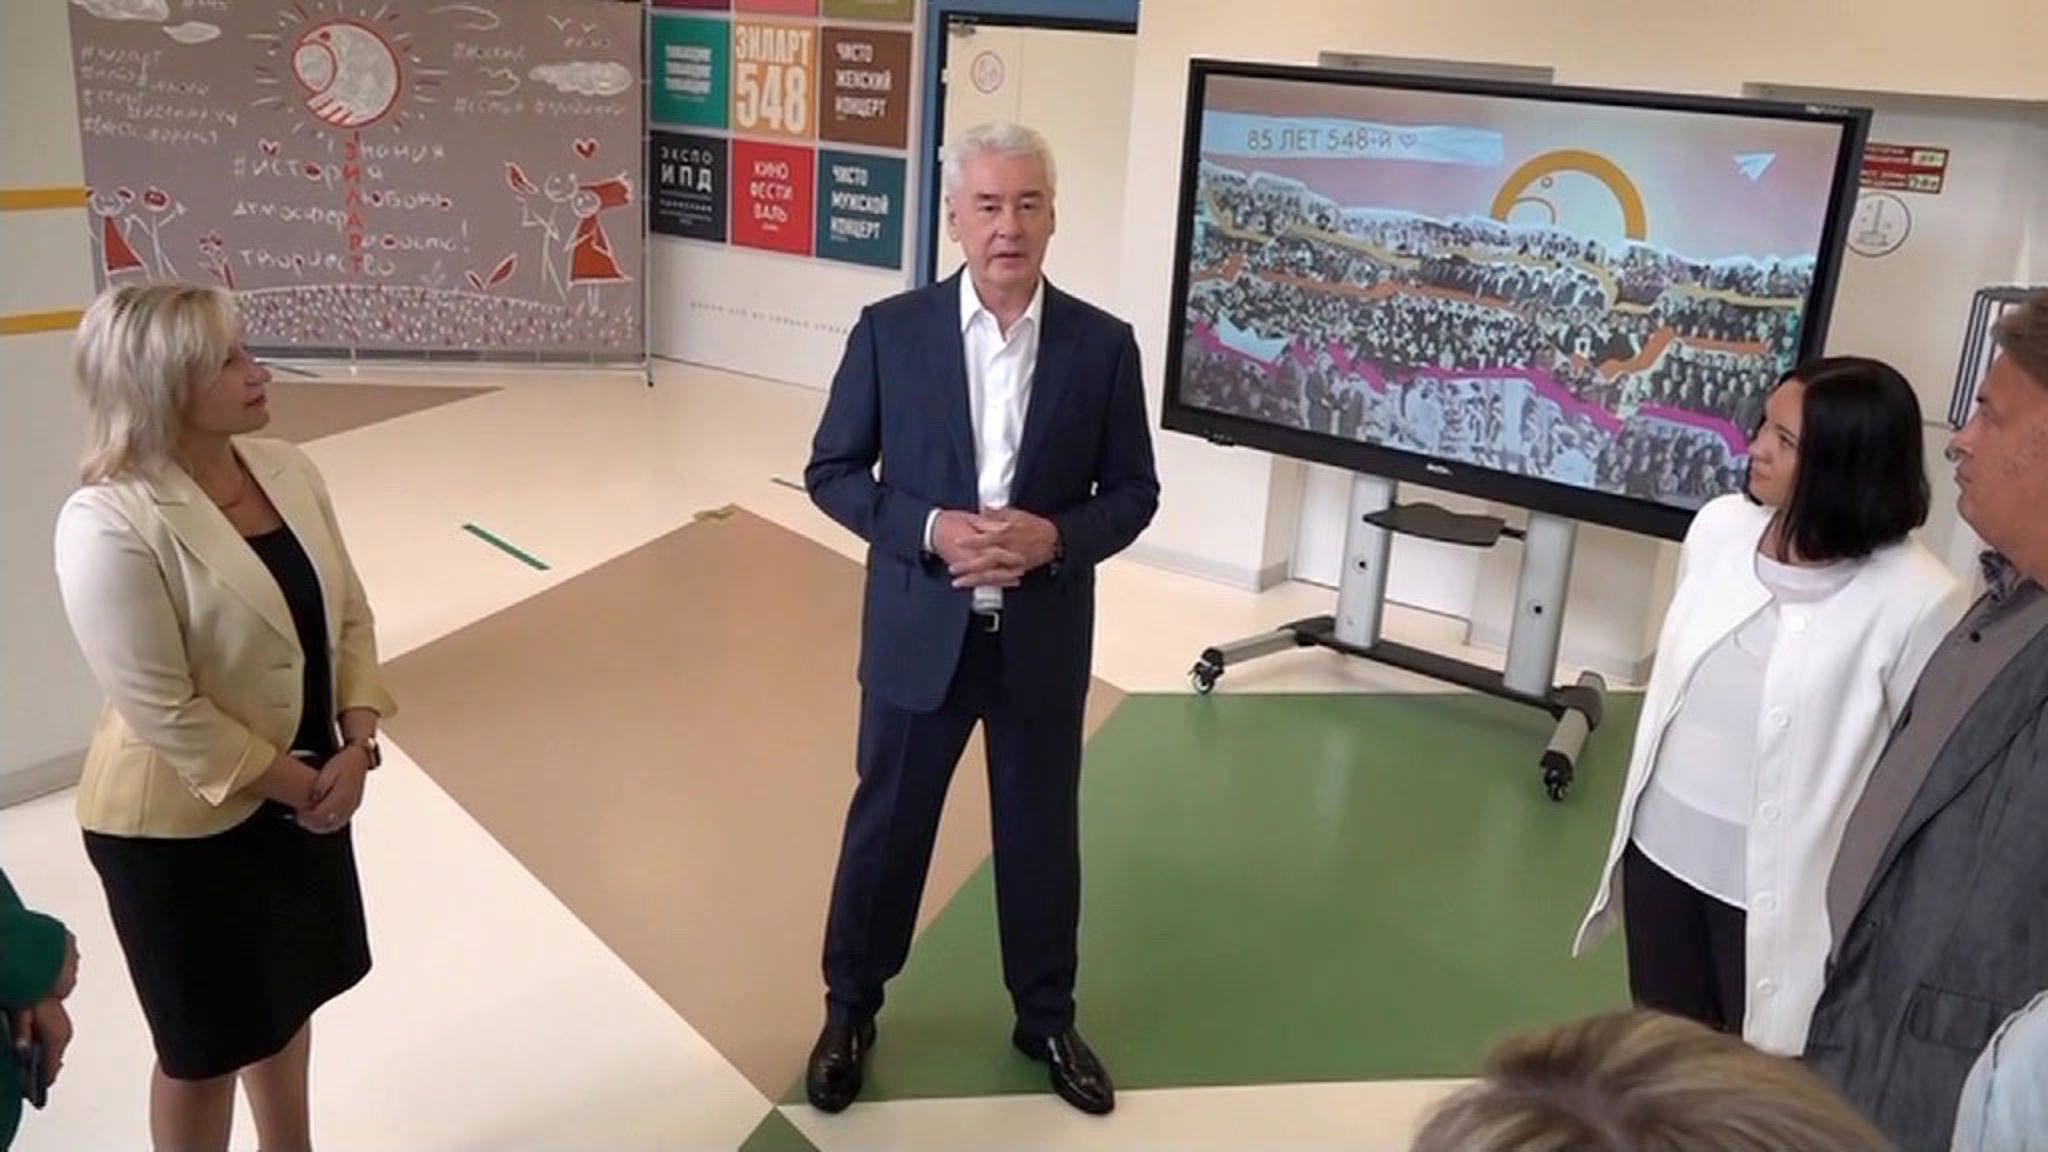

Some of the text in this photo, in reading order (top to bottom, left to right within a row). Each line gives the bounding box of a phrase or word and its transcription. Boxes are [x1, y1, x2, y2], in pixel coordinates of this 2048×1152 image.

[735, 25, 812, 66] ЗИЛАРТ
[836, 42, 873, 63] ЧИСТО
[835, 69, 892, 91] ЖЕНСКИЙ
[735, 62, 808, 134] 548
[835, 95, 887, 117] КОНЦЕРТ
[1247, 128, 1273, 150] 85
[1279, 128, 1320, 150] ЛЕТ
[661, 146, 713, 166] ЭКСПО
[660, 164, 713, 193] ИПД
[753, 160, 789, 180] КИНО
[831, 164, 869, 187] ЧИСТО
[750, 181, 794, 201] ФЕСТИ
[753, 202, 789, 223] ВАЛЬ
[831, 190, 889, 215] МУЖСКОЙ
[830, 216, 882, 240] КОНЦЕРТ
